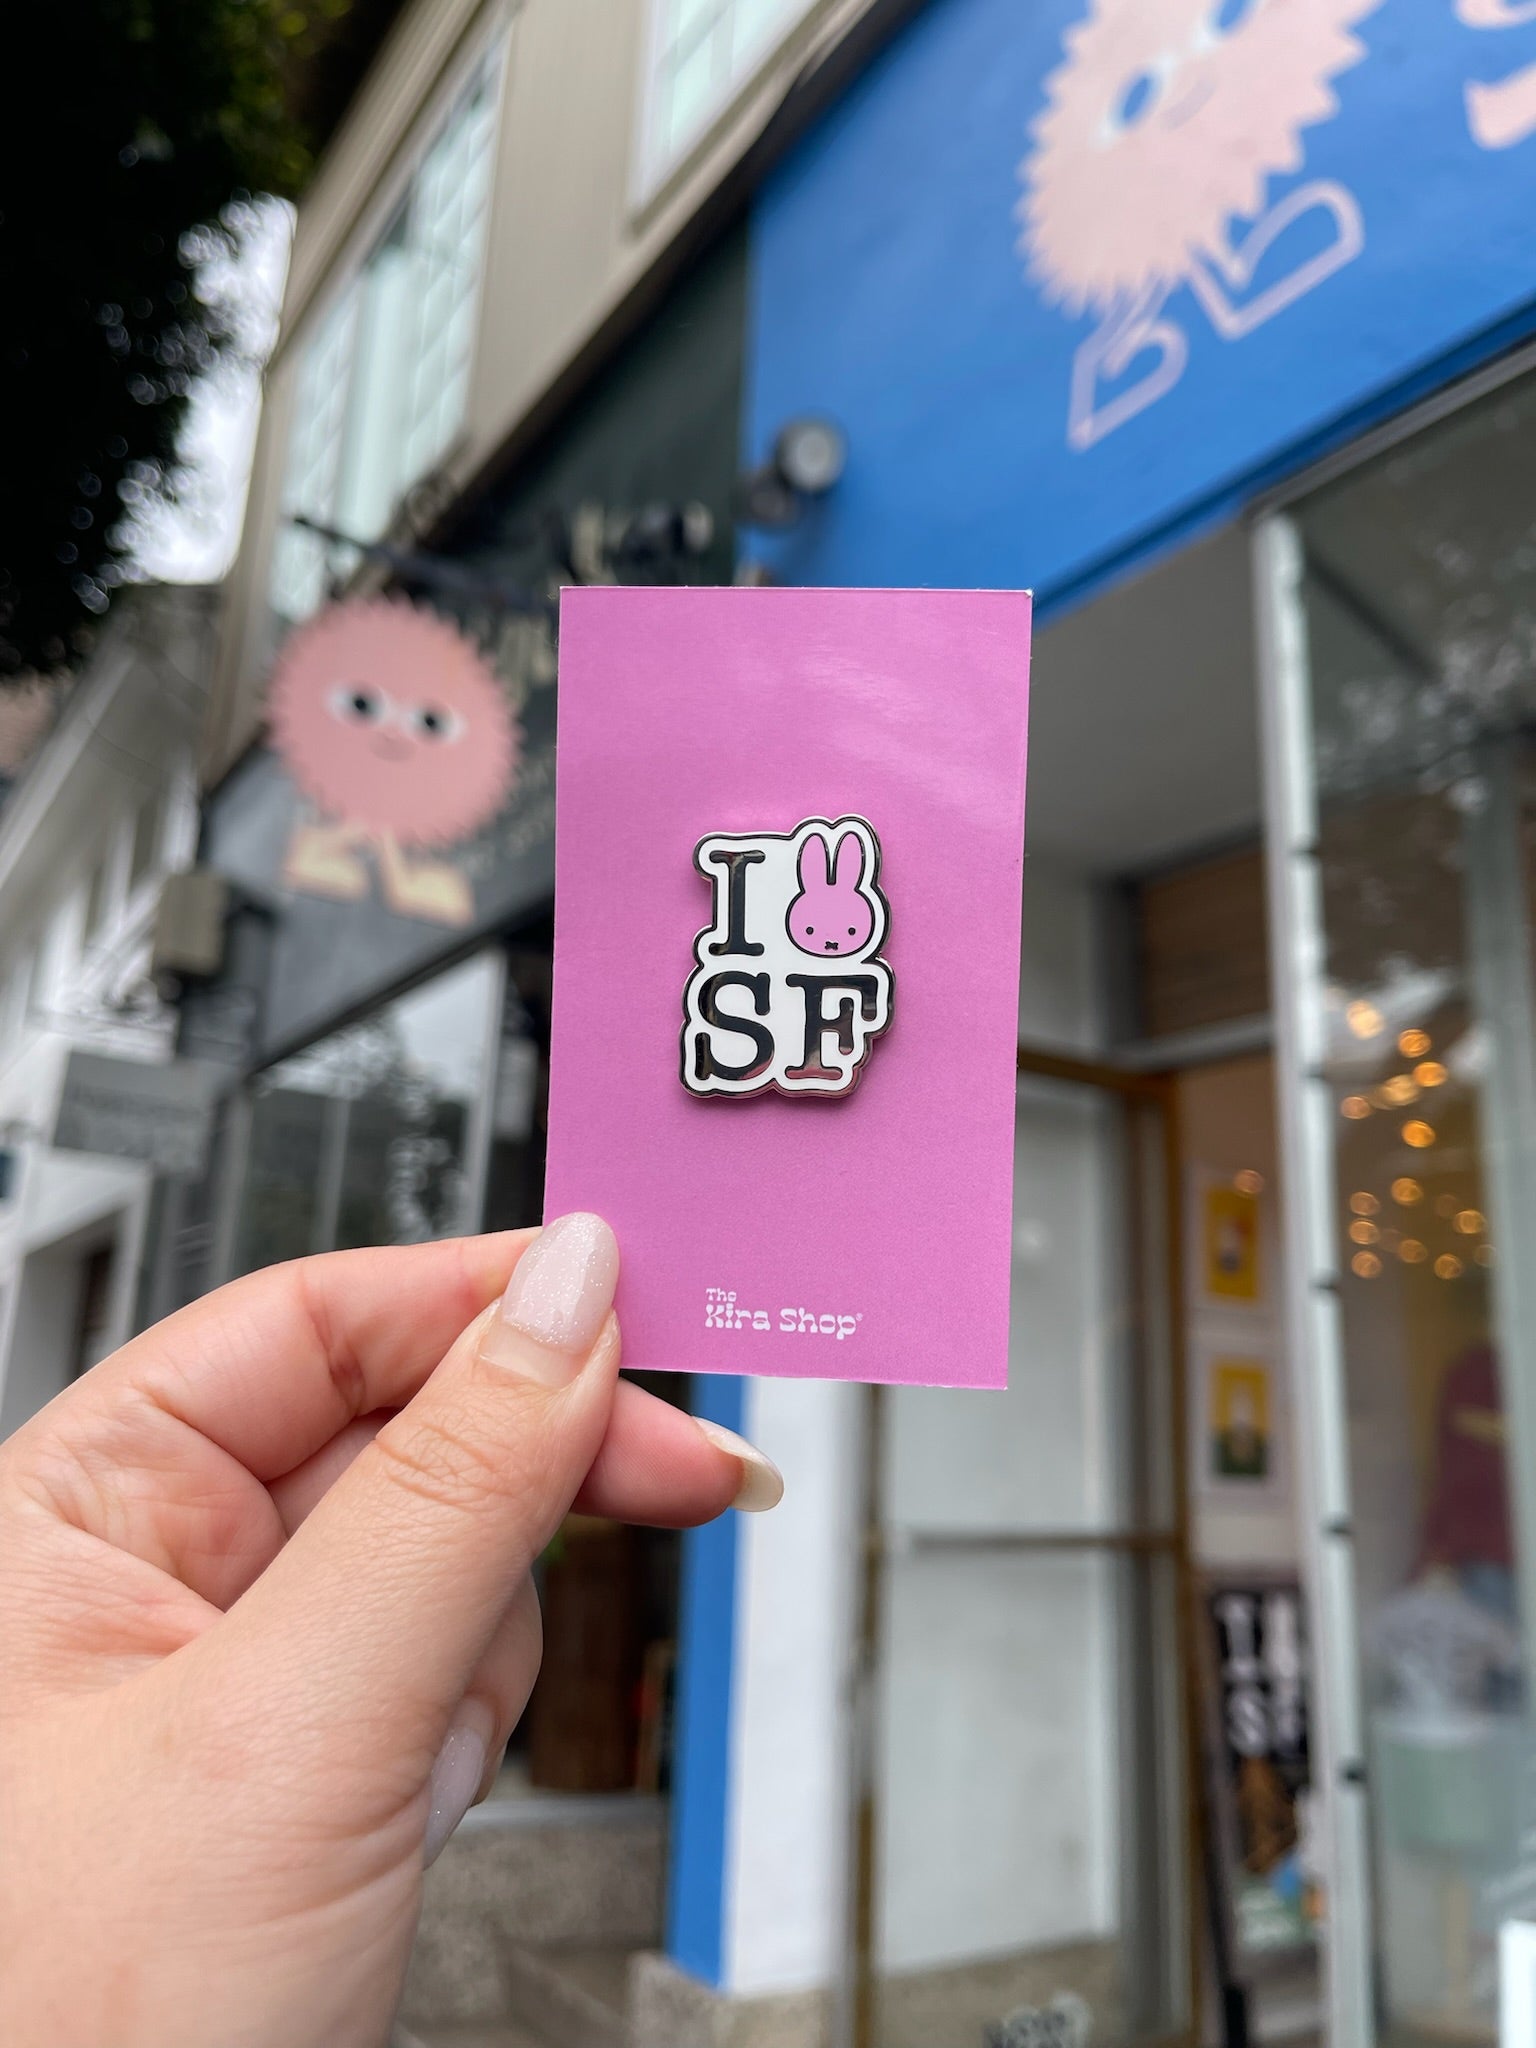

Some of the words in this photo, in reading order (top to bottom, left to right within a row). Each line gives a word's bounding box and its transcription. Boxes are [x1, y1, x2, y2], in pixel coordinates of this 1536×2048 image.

[709, 850, 766, 956] I
[695, 971, 879, 1081] SF
[704, 1302, 771, 1331] Kira
[705, 1287, 737, 1302] The
